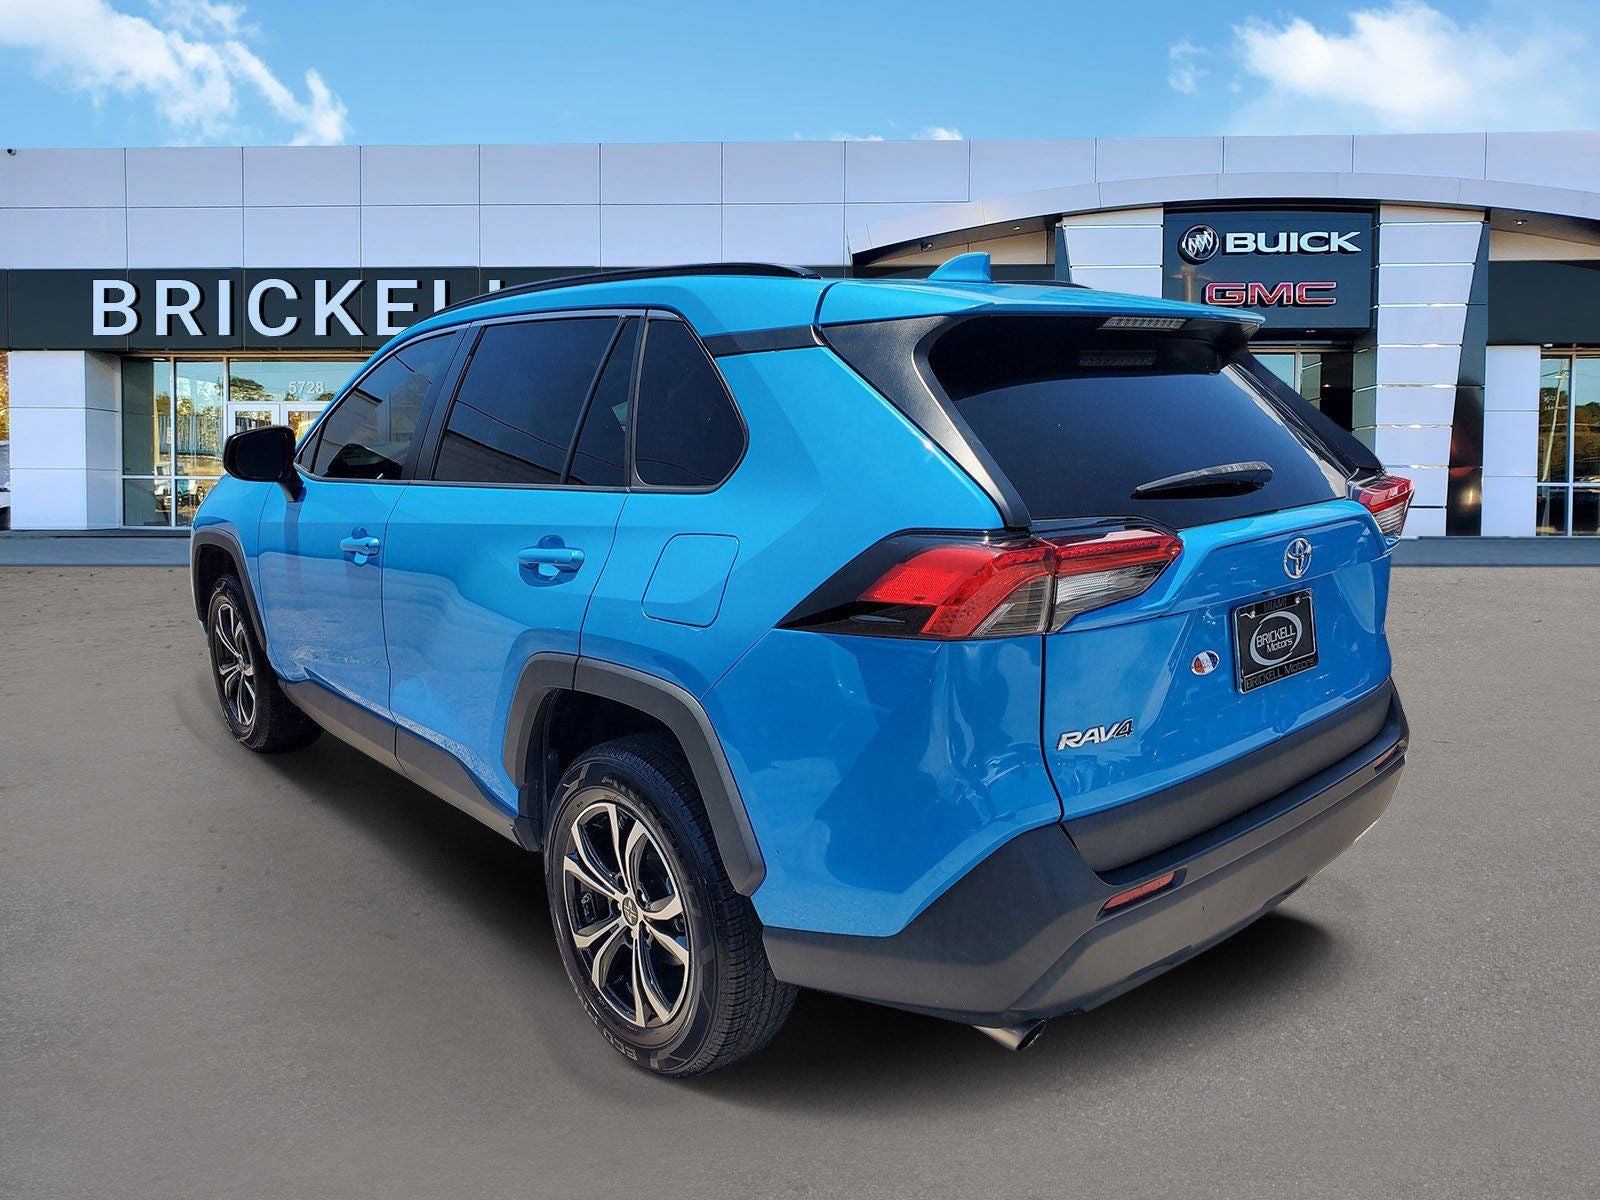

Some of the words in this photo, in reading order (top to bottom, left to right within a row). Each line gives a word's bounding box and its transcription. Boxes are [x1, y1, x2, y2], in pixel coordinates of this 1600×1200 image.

[1225, 231, 1362, 253] BUICK
[1205, 281, 1337, 305] GMC
[92, 279, 501, 336] BRICKE
[289, 380, 324, 394] 5728
[1256, 624, 1296, 649] BRICKELL
[1266, 637, 1293, 654] Motors
[1057, 717, 1134, 751] RAV4
